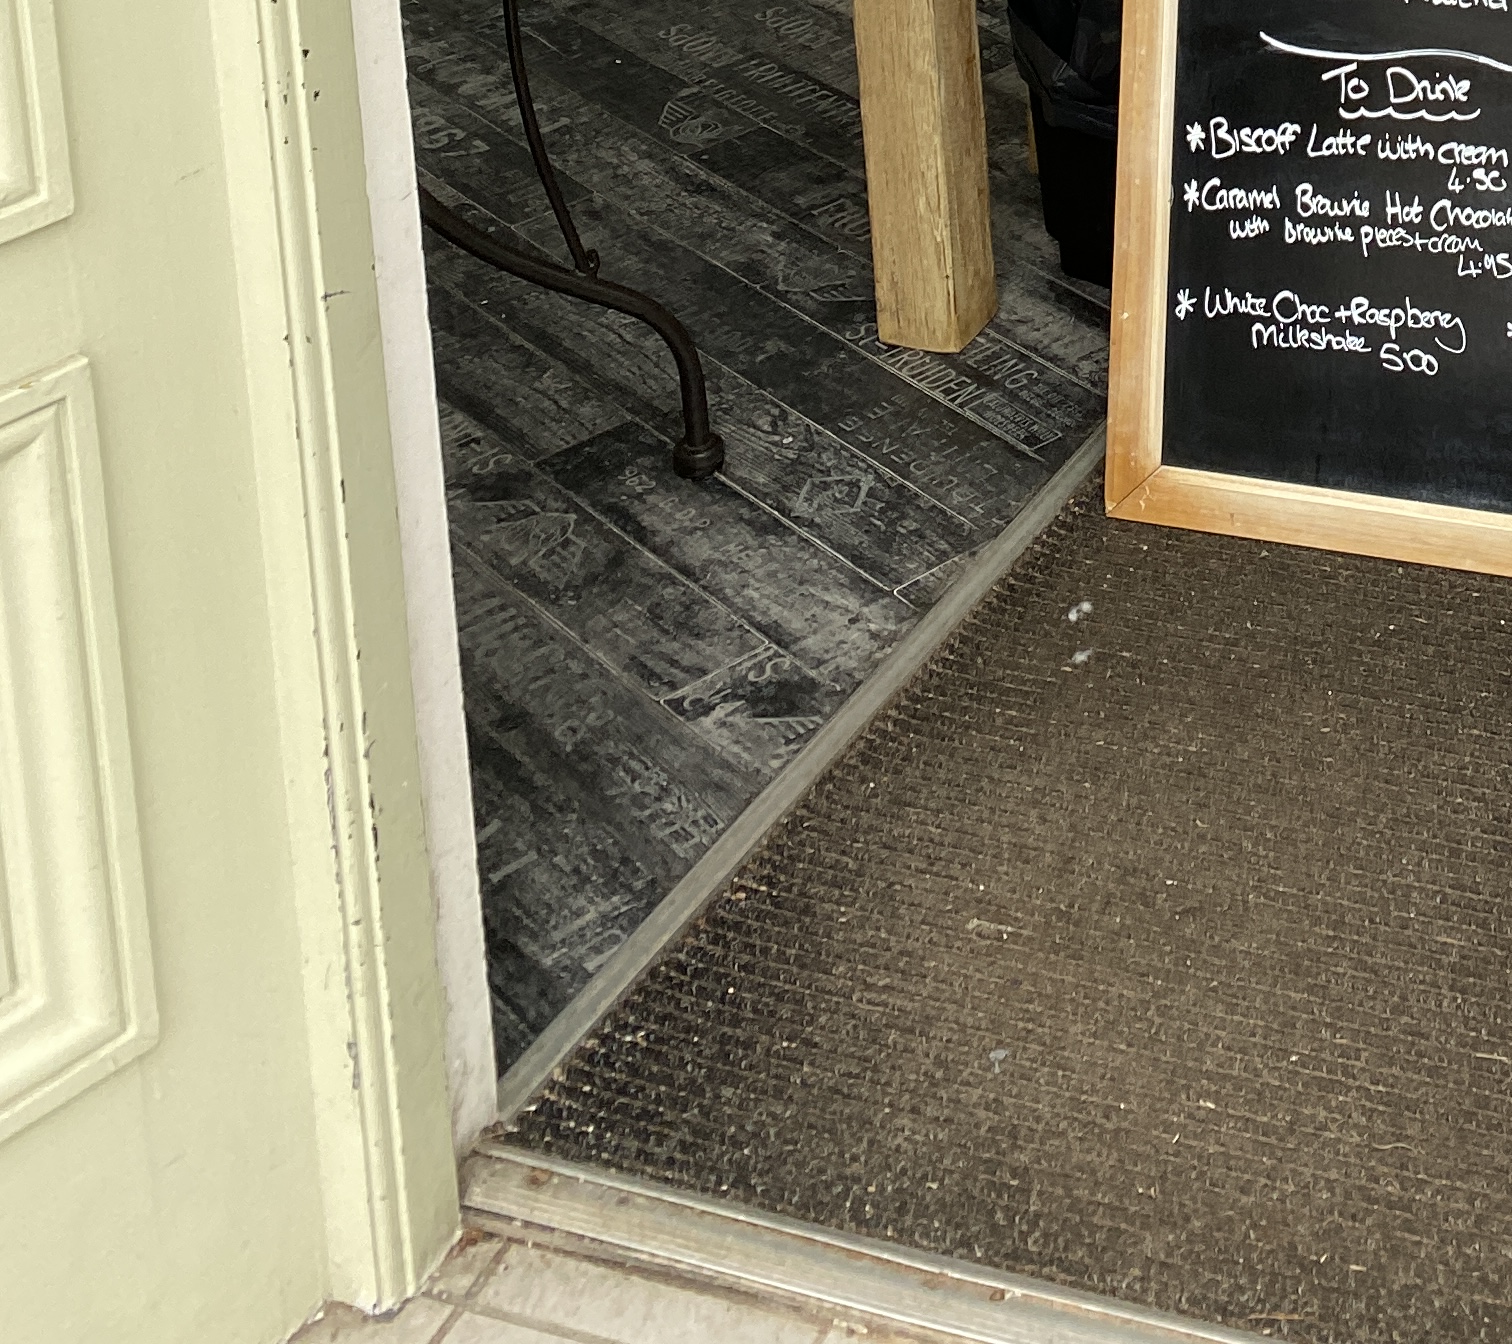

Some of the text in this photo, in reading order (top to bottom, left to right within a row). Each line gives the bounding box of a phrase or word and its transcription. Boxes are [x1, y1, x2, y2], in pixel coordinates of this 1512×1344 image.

[1321, 62, 1470, 104] To Drink
[1210, 116, 1509, 168] Biscoff Latte with cream
[1202, 177, 1280, 211] Caramel
[1295, 182, 1370, 218] Brownie
[1386, 190, 1424, 225] Hot
[1229, 214, 1270, 239] with
[1284, 217, 1354, 245] brownie
[1205, 286, 1467, 353] White Choc Raspberry
[1251, 324, 1372, 352] Milkshake
